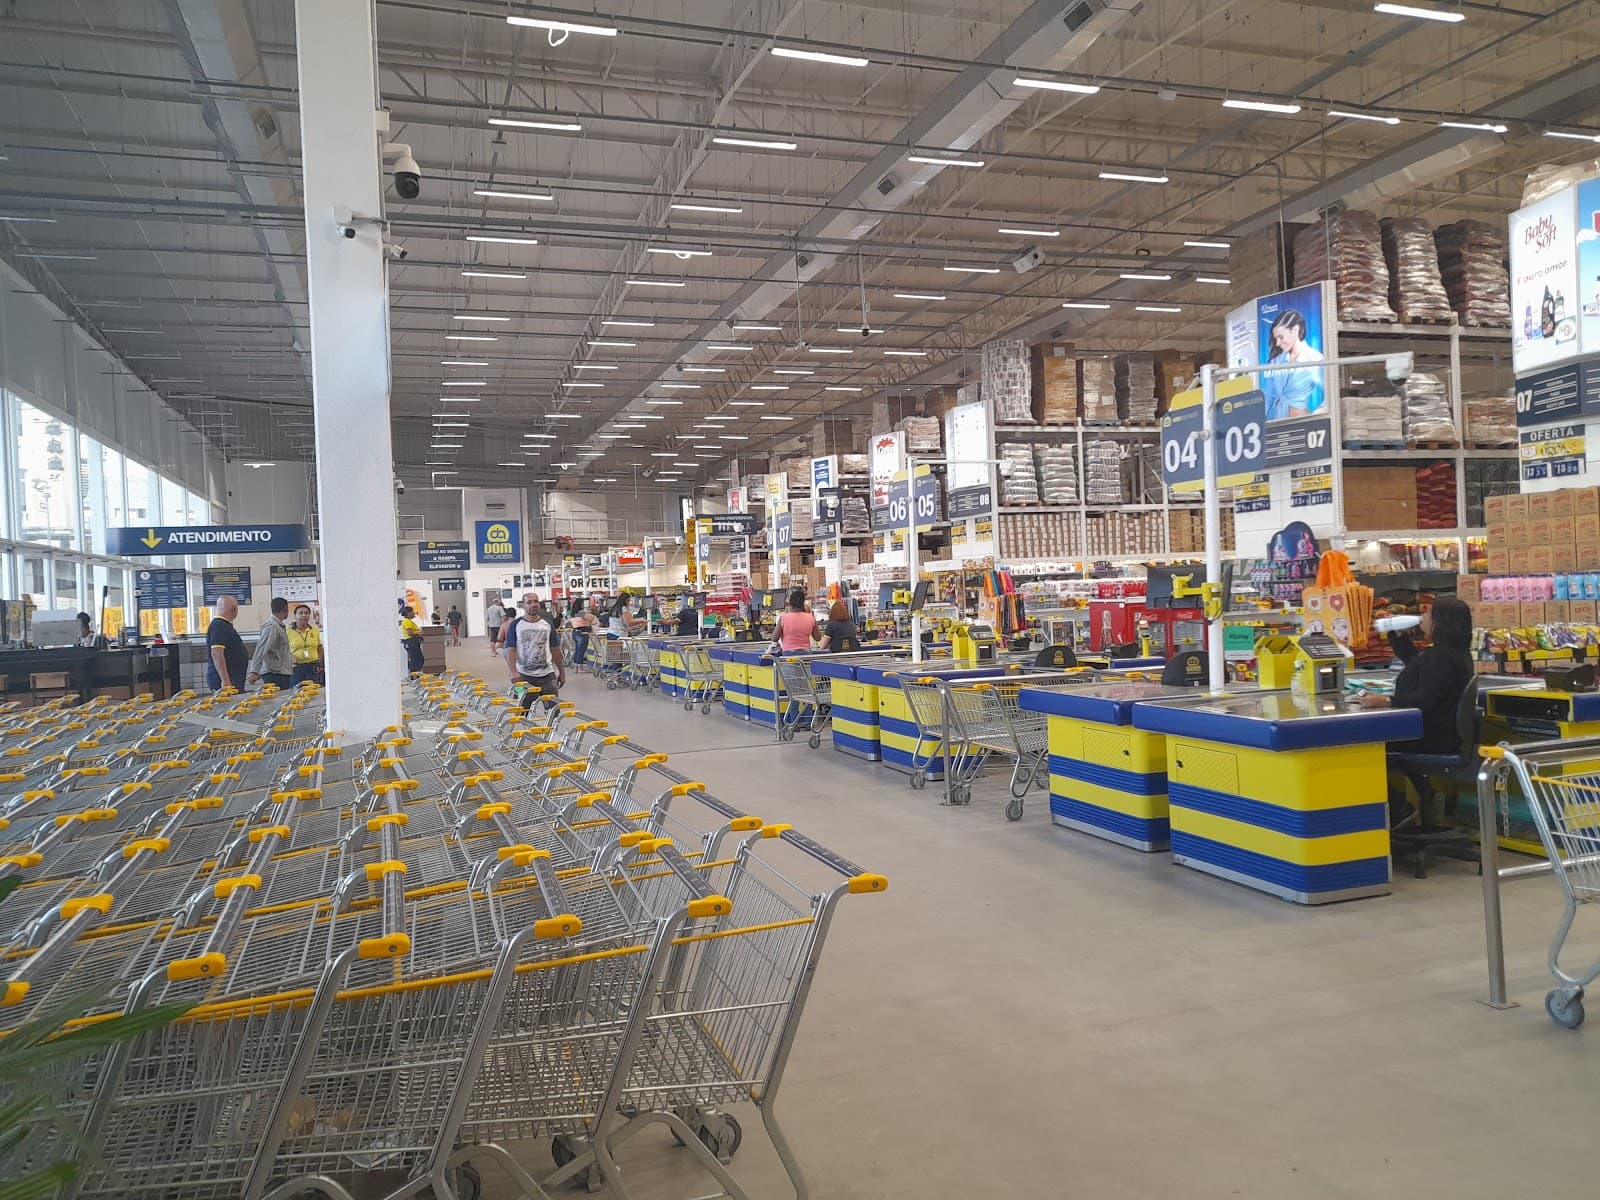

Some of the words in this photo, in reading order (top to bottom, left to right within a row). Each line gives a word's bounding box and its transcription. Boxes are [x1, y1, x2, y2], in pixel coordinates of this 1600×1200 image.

[1525, 214, 1553, 245] Baby
[1535, 223, 1558, 253] Soft
[1517, 389, 1533, 413] 07
[1225, 422, 1261, 462] 03
[1307, 430, 1326, 448] 07
[1530, 427, 1574, 442] OFERTA
[1164, 431, 1198, 473] 04
[1296, 466, 1325, 477] OFERTA
[889, 497, 907, 521] 06
[918, 493, 934, 518] 05
[167, 530, 272, 544] ATENDIMENTO
[779, 525, 790, 543] 07
[483, 543, 512, 554] DOM
[700, 544, 709, 557] 09
